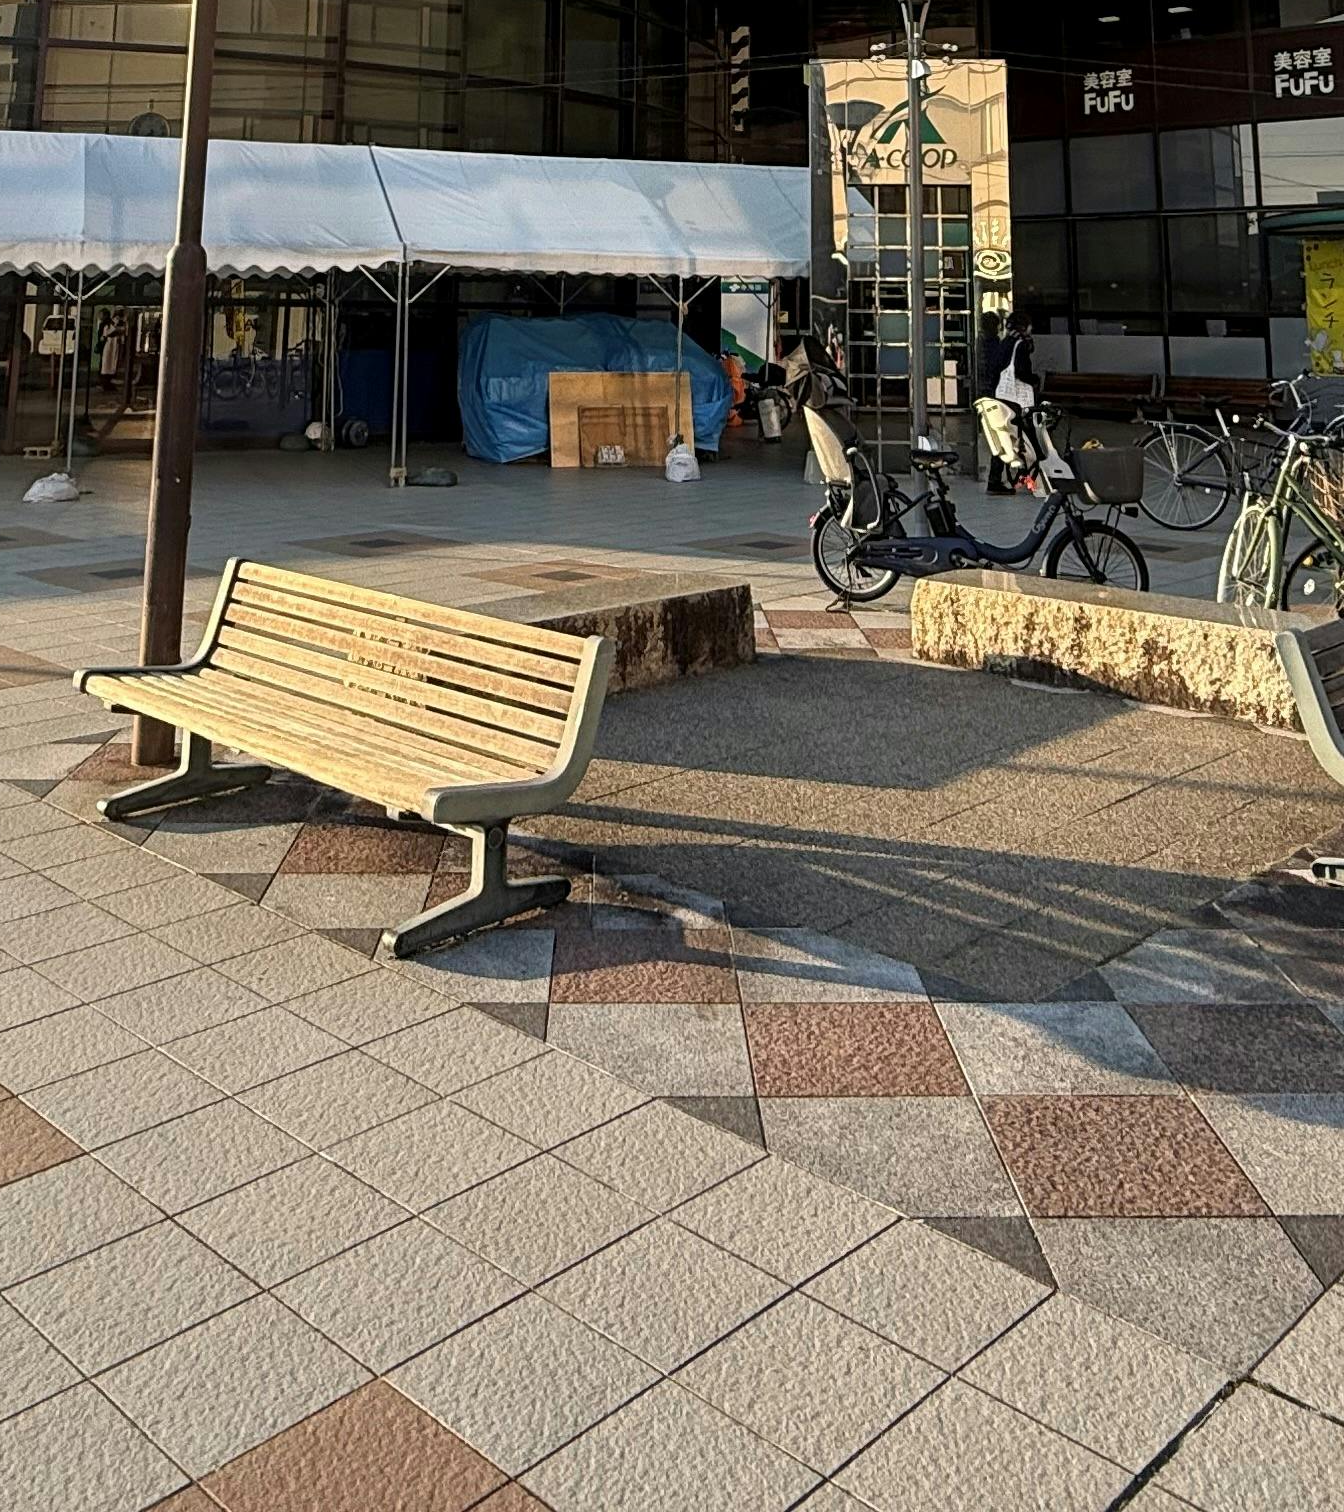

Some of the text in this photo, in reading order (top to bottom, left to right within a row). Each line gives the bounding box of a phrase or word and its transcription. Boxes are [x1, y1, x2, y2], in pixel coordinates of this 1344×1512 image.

[1274, 48, 1333, 71] 美容室
[1083, 68, 1133, 90] 美容室
[1274, 71, 1335, 98] FuFu
[1084, 90, 1134, 115] FuFu
[1320, 273, 1340, 328] ランチ
